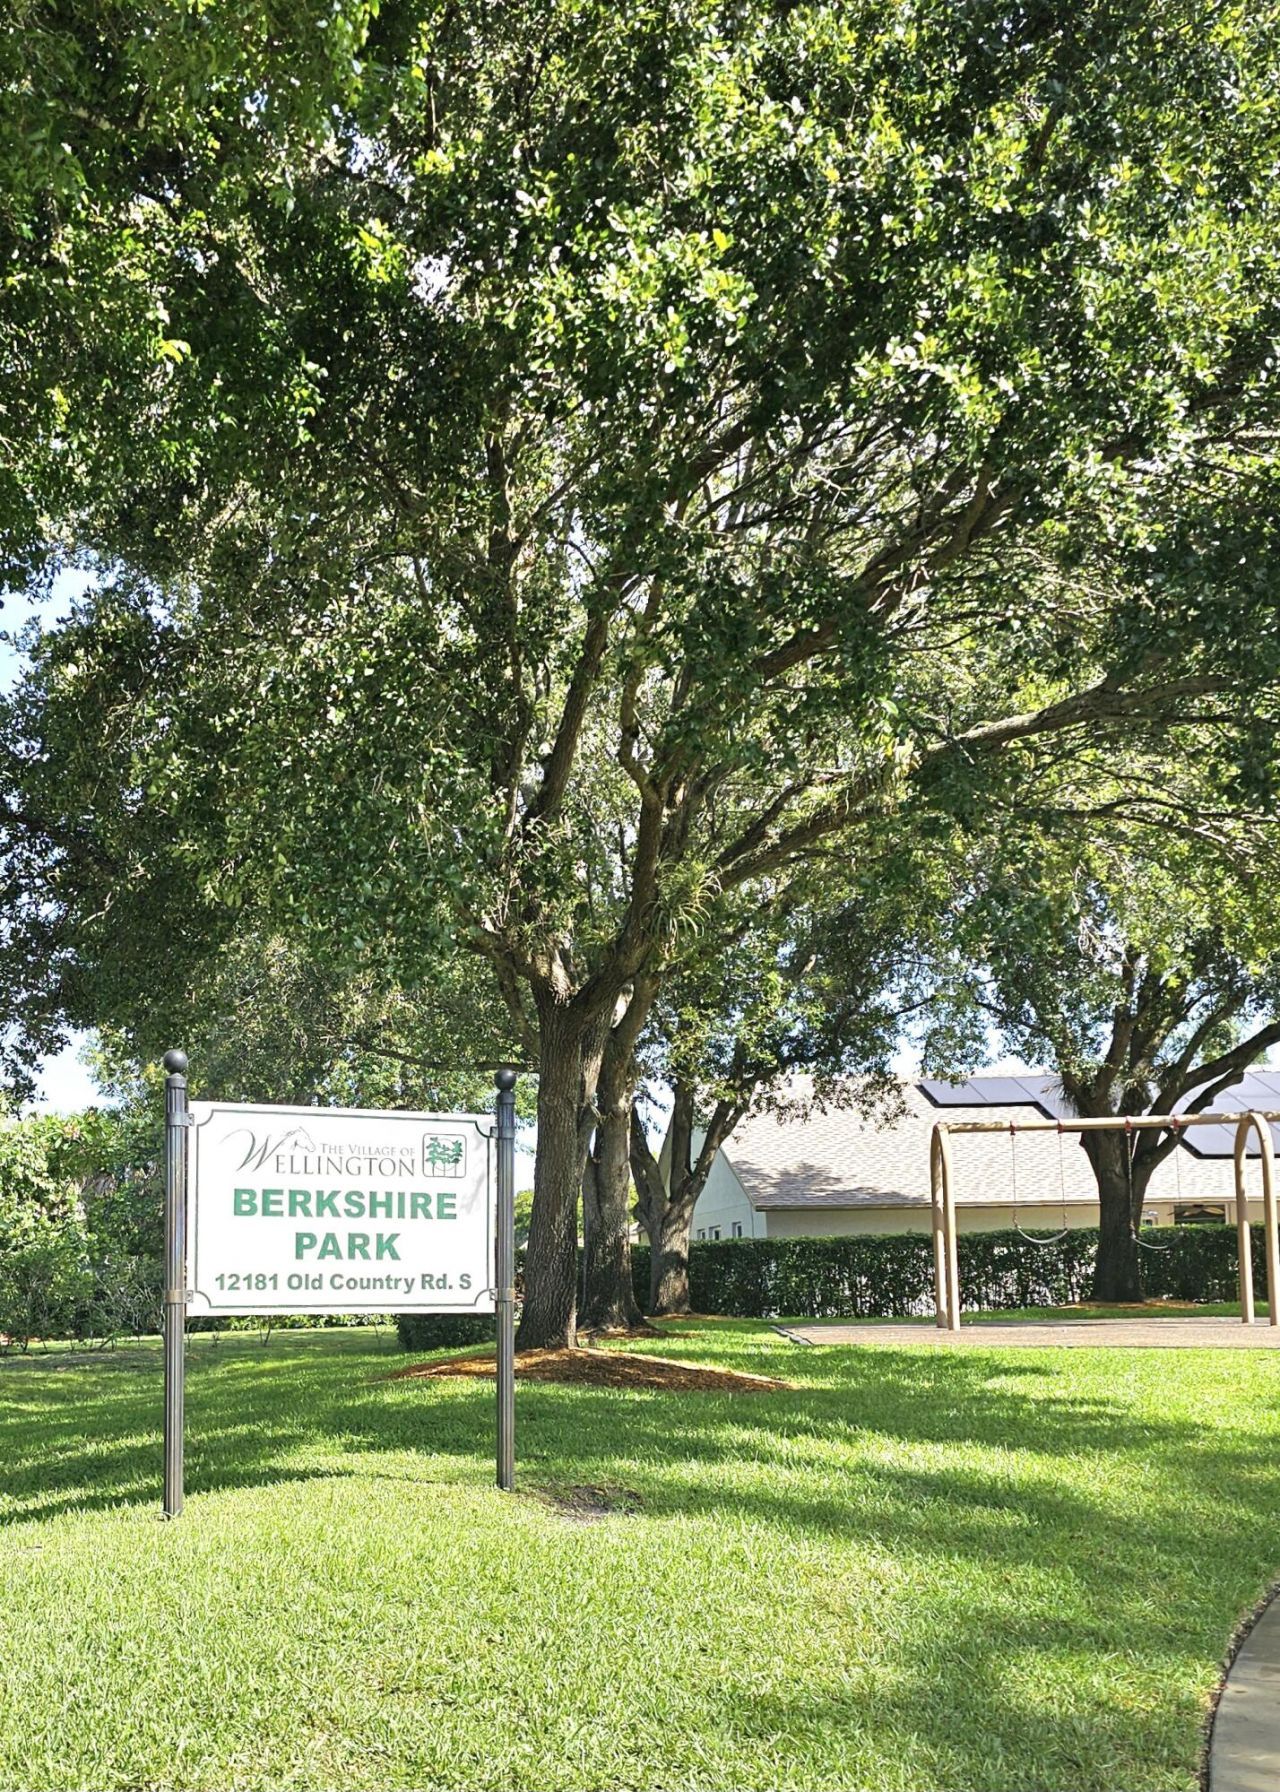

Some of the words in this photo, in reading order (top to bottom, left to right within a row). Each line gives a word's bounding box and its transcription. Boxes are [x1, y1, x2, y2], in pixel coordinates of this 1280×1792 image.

[220, 1128, 415, 1177] WELLINGTON
[321, 1143, 344, 1155] THE
[347, 1144, 397, 1156] VILLAGE
[233, 1188, 457, 1220] BERKSHIRE
[295, 1232, 401, 1261] PARK
[215, 1273, 279, 1291] 12181
[287, 1273, 323, 1291] Old
[329, 1274, 415, 1294] Country
[421, 1274, 453, 1291] Rd.
[459, 1274, 472, 1291] S
